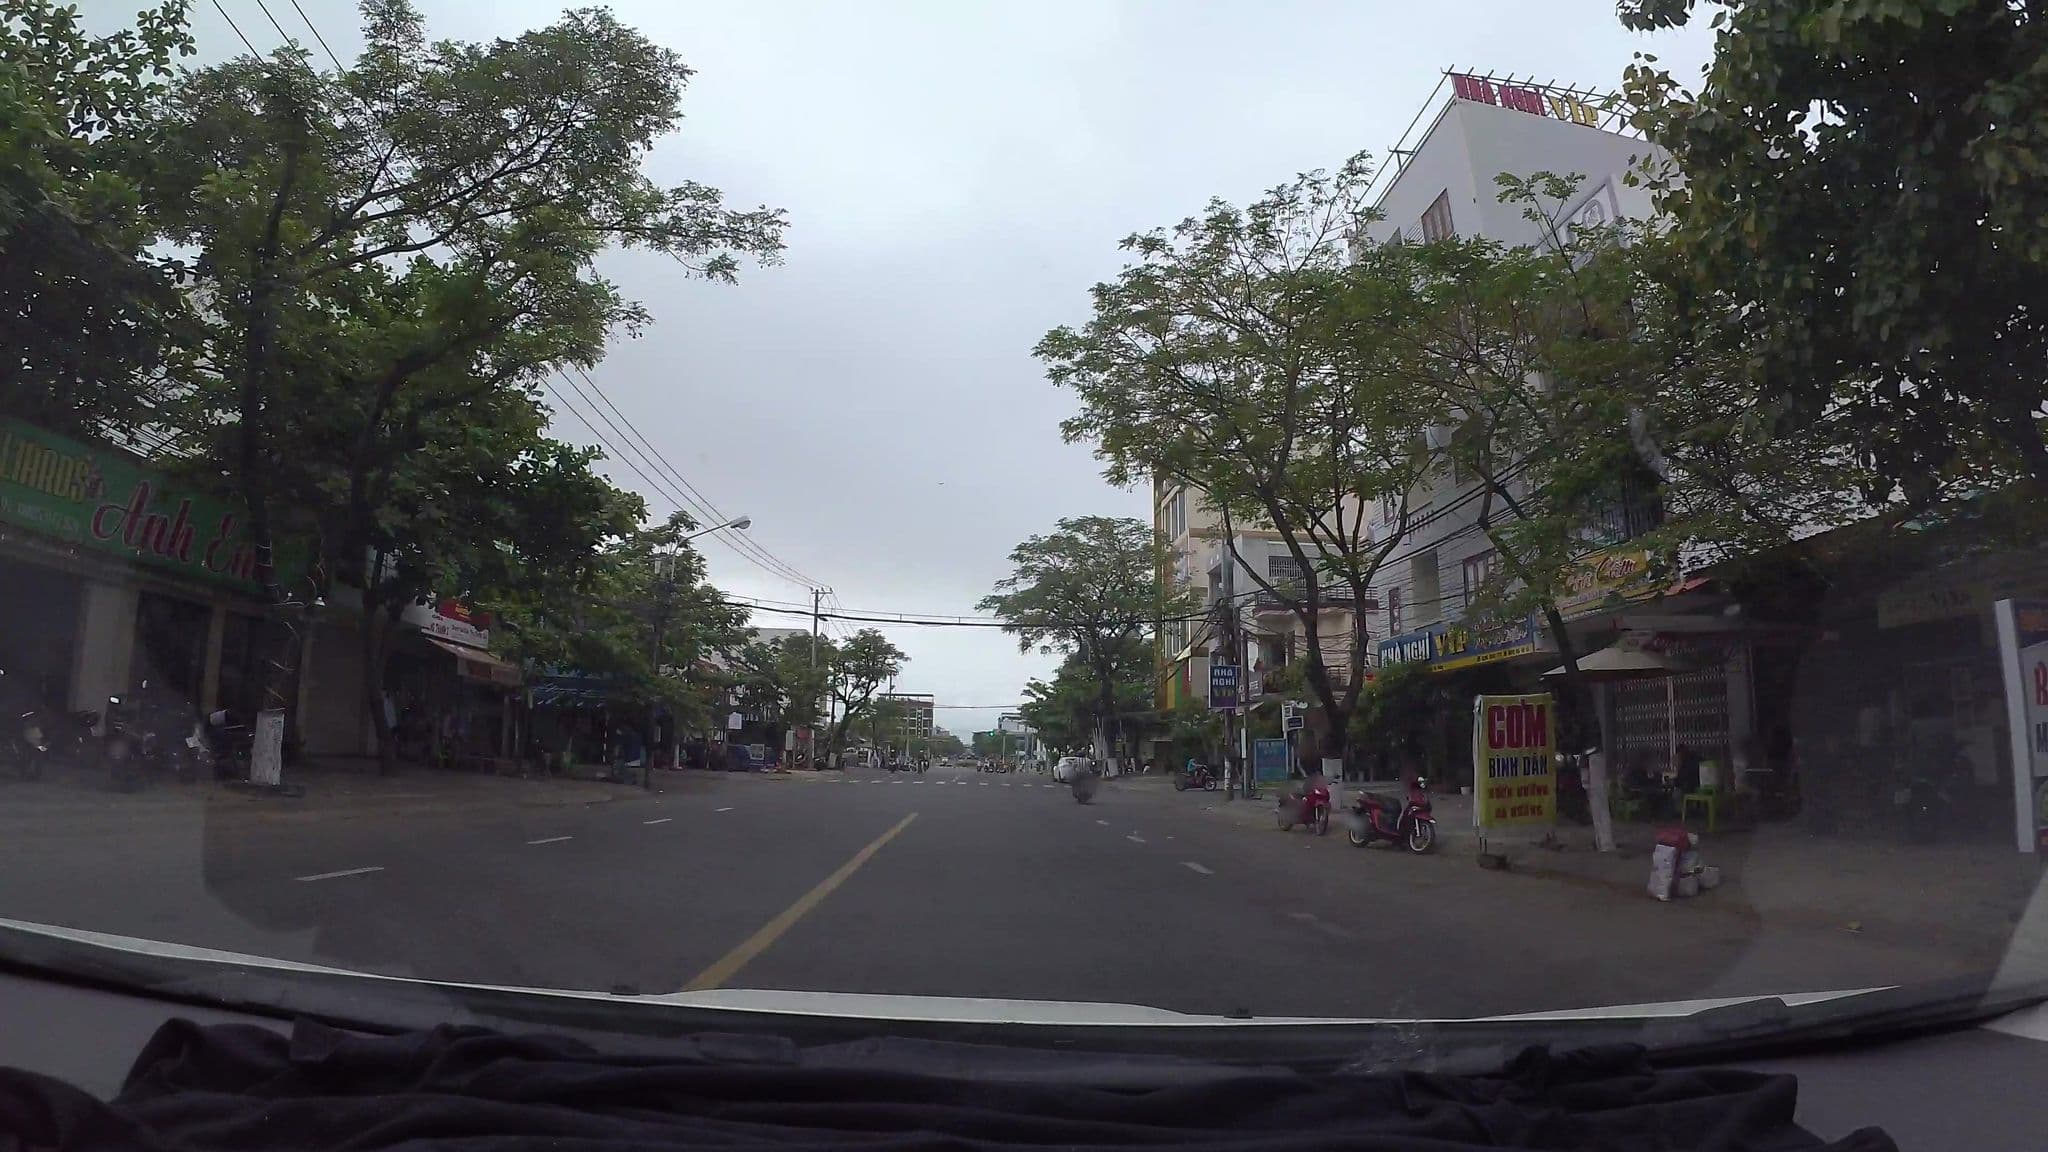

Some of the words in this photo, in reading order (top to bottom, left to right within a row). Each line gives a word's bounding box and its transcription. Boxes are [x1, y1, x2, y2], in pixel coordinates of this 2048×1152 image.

[91, 480, 195, 564] Anh
[1487, 698, 1547, 749] CƠM
[1488, 755, 1518, 778] BÌNH
[1523, 753, 1548, 776] DÂN
